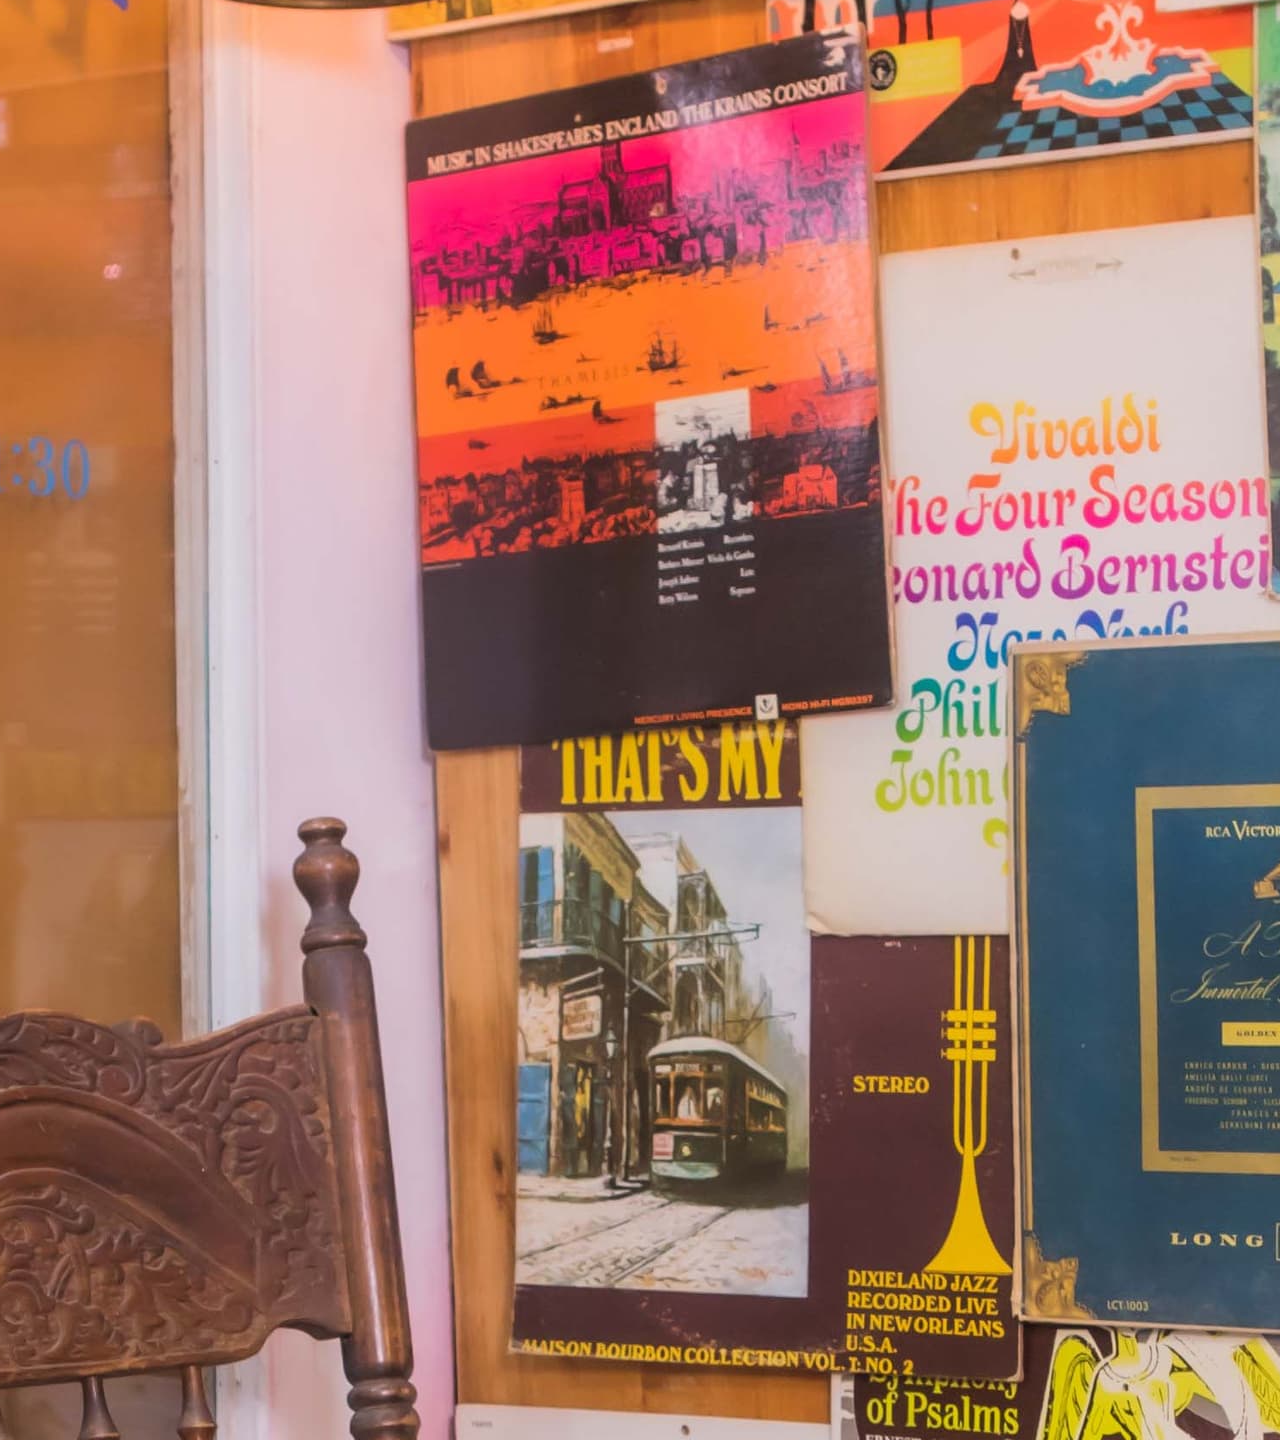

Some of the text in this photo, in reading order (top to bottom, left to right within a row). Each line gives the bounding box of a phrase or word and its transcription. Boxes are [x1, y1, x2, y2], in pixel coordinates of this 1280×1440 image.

[427, 71, 849, 177] MUSIC IN SHAKESPEARE'S ENGLAND THE KRAINIS CONSORT
[968, 392, 1162, 464] Vivaldi
[887, 474, 948, 537] he
[955, 473, 1077, 537] Four
[1051, 533, 1270, 600] Bernstei
[552, 719, 787, 805] THAT'S MY
[874, 747, 991, 813] John
[1205, 826, 1231, 839] RCA
[1203, 920, 1263, 958] A
[1235, 1029, 1278, 1038] GOLDEN
[852, 1074, 930, 1095] STEREO
[1169, 1232, 1264, 1248] LONG
[847, 1269, 999, 1294] DIXIELAND JAZZ
[846, 1312, 866, 1330] IN
[847, 1291, 999, 1316] RECORDED LIVE
[521, 1338, 914, 1376] MAISON BOURBON COLLECTION VOL. NO. 2
[846, 1334, 898, 1354] U.S.A.
[866, 1391, 1020, 1436] of Psalms
